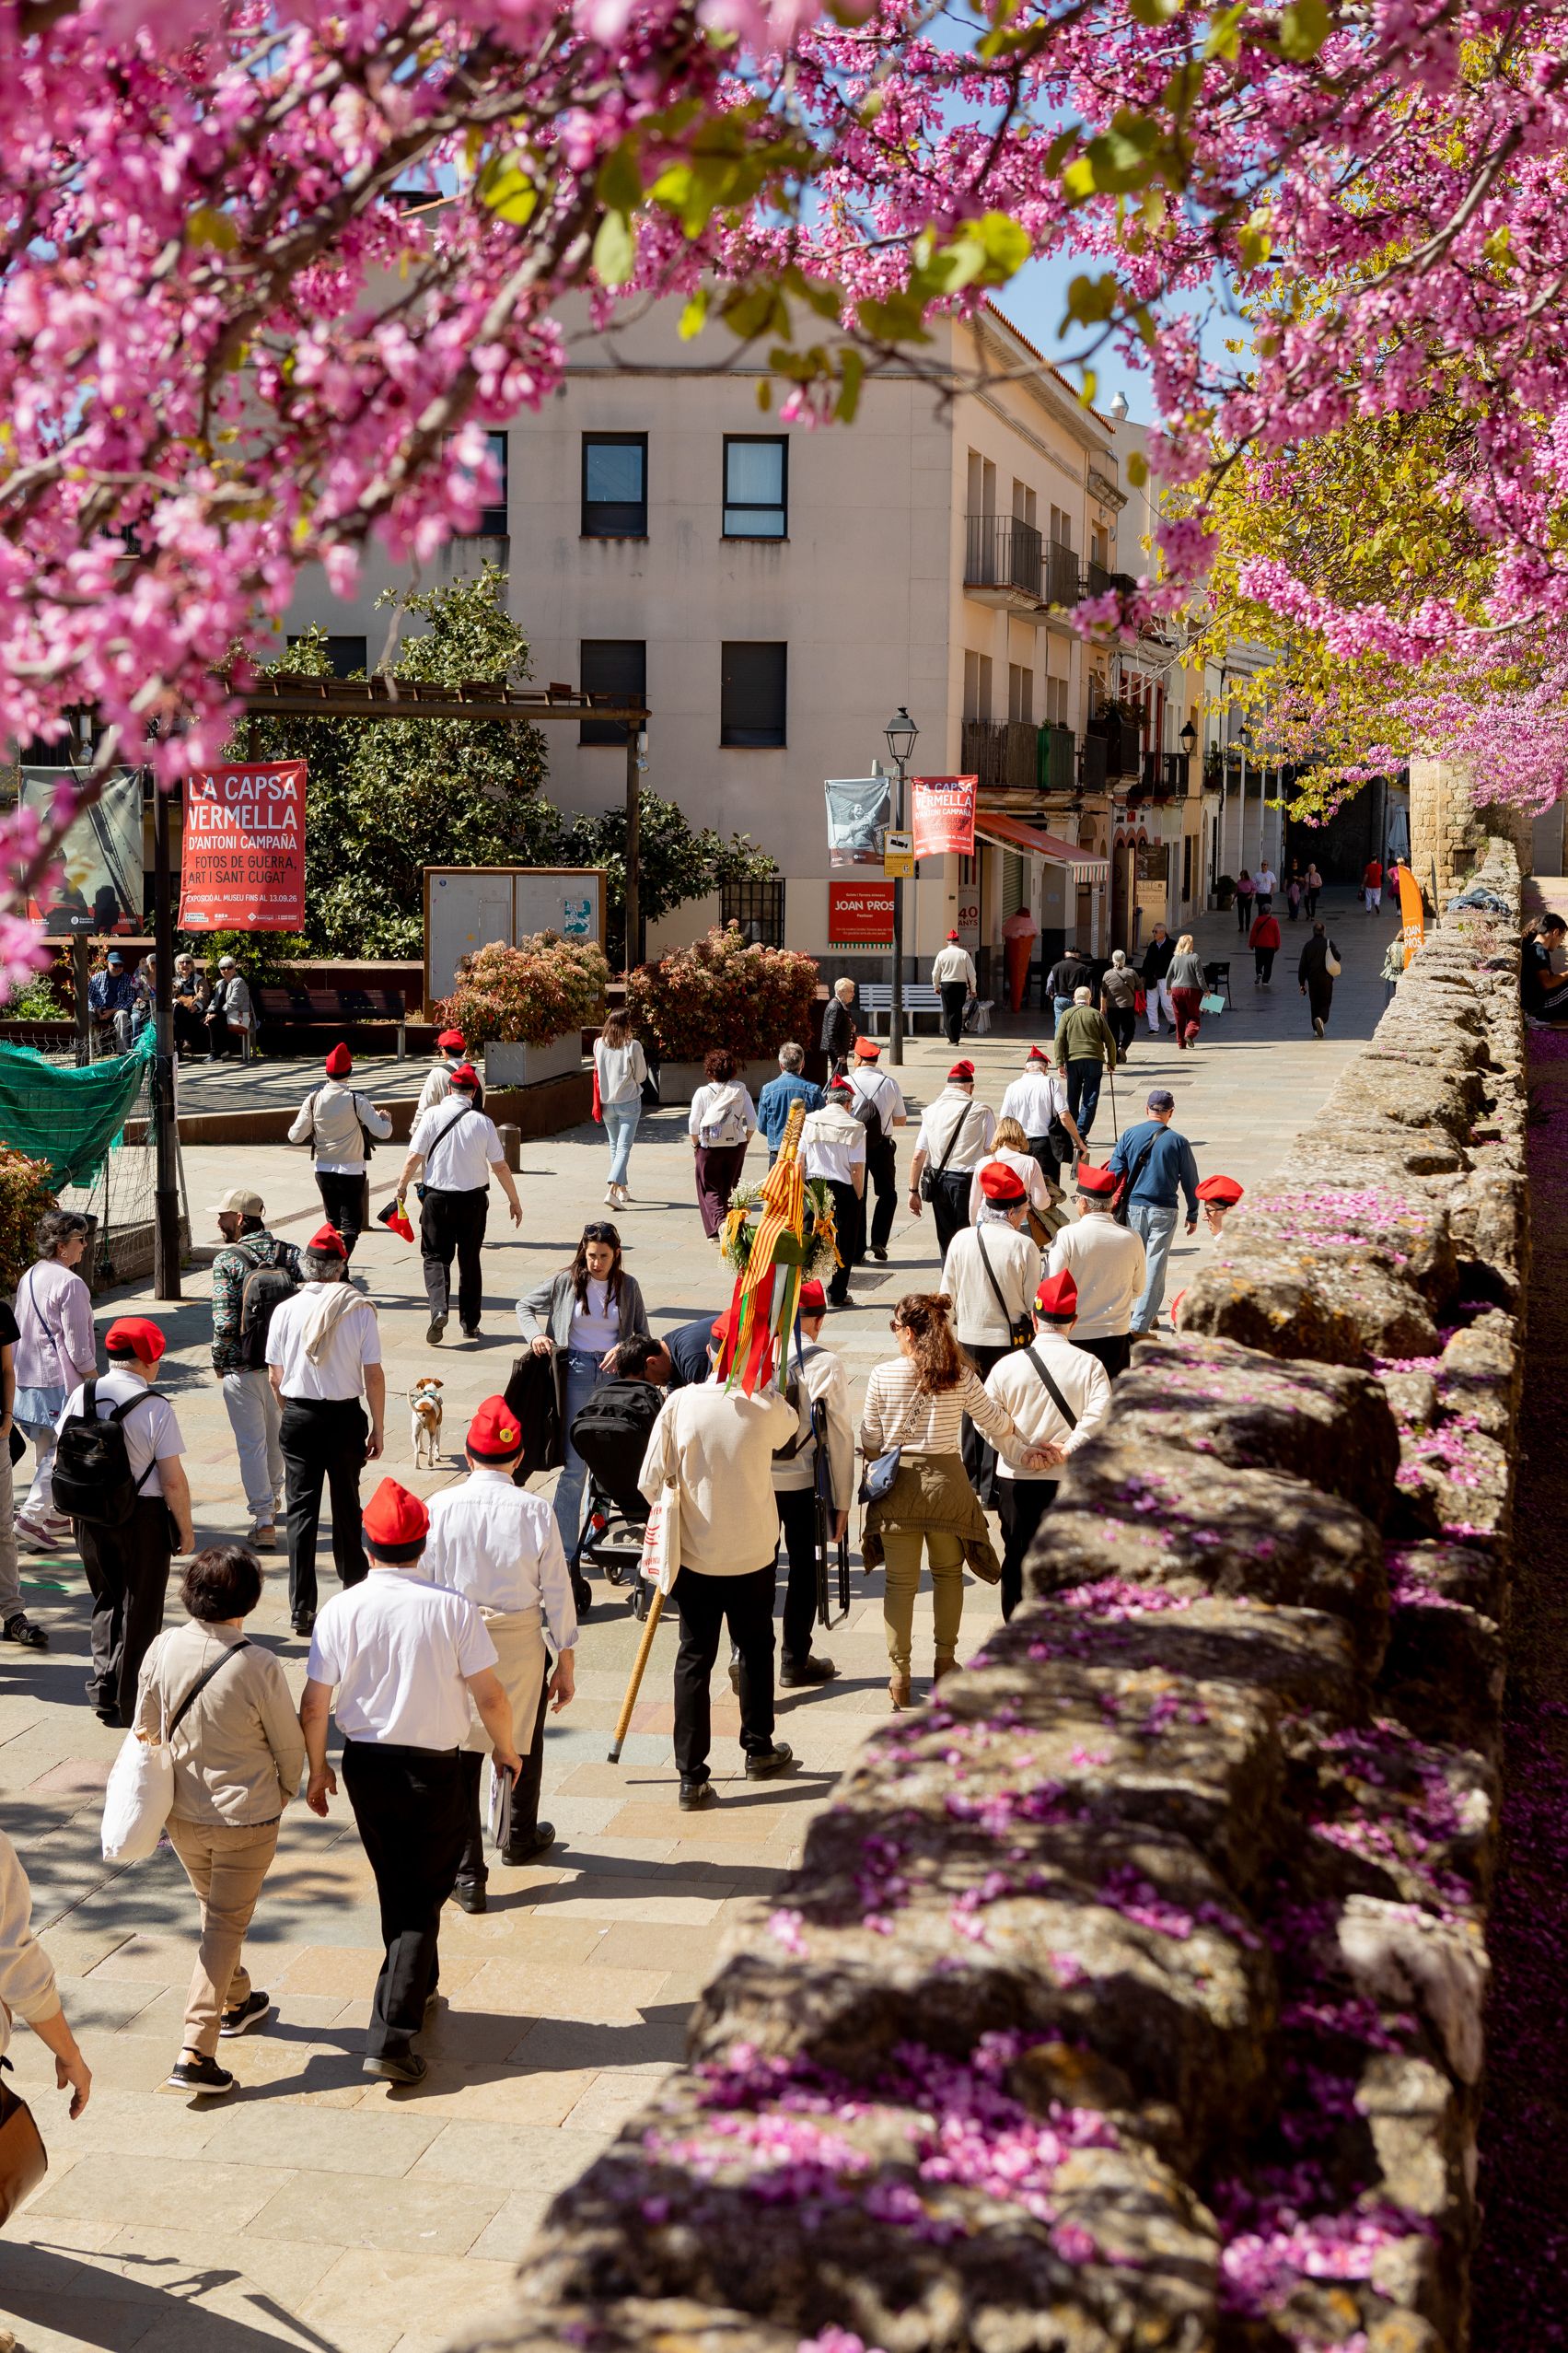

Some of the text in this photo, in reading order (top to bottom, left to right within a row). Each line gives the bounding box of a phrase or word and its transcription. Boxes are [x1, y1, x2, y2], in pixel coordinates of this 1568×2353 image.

[188, 775, 298, 800] LA CAPSA
[915, 783, 972, 795] LA CAPSA
[915, 794, 972, 809] VERMELLA
[188, 805, 298, 831] VERMELLA
[189, 833, 297, 850] D'ANTONI CAMPAÑÀ
[195, 856, 297, 871] FOTOS DE GUERRA,
[187, 870, 285, 884] ART I SANT CUGAT
[186, 893, 214, 903] EXPOSICIÓ
[260, 894, 267, 903] AL
[270, 894, 297, 903] 13.09.26
[835, 900, 895, 911] JOAN PROS
[958, 906, 978, 919] 40
[1404, 924, 1421, 938] JOAN
[1404, 937, 1422, 949] PROS
